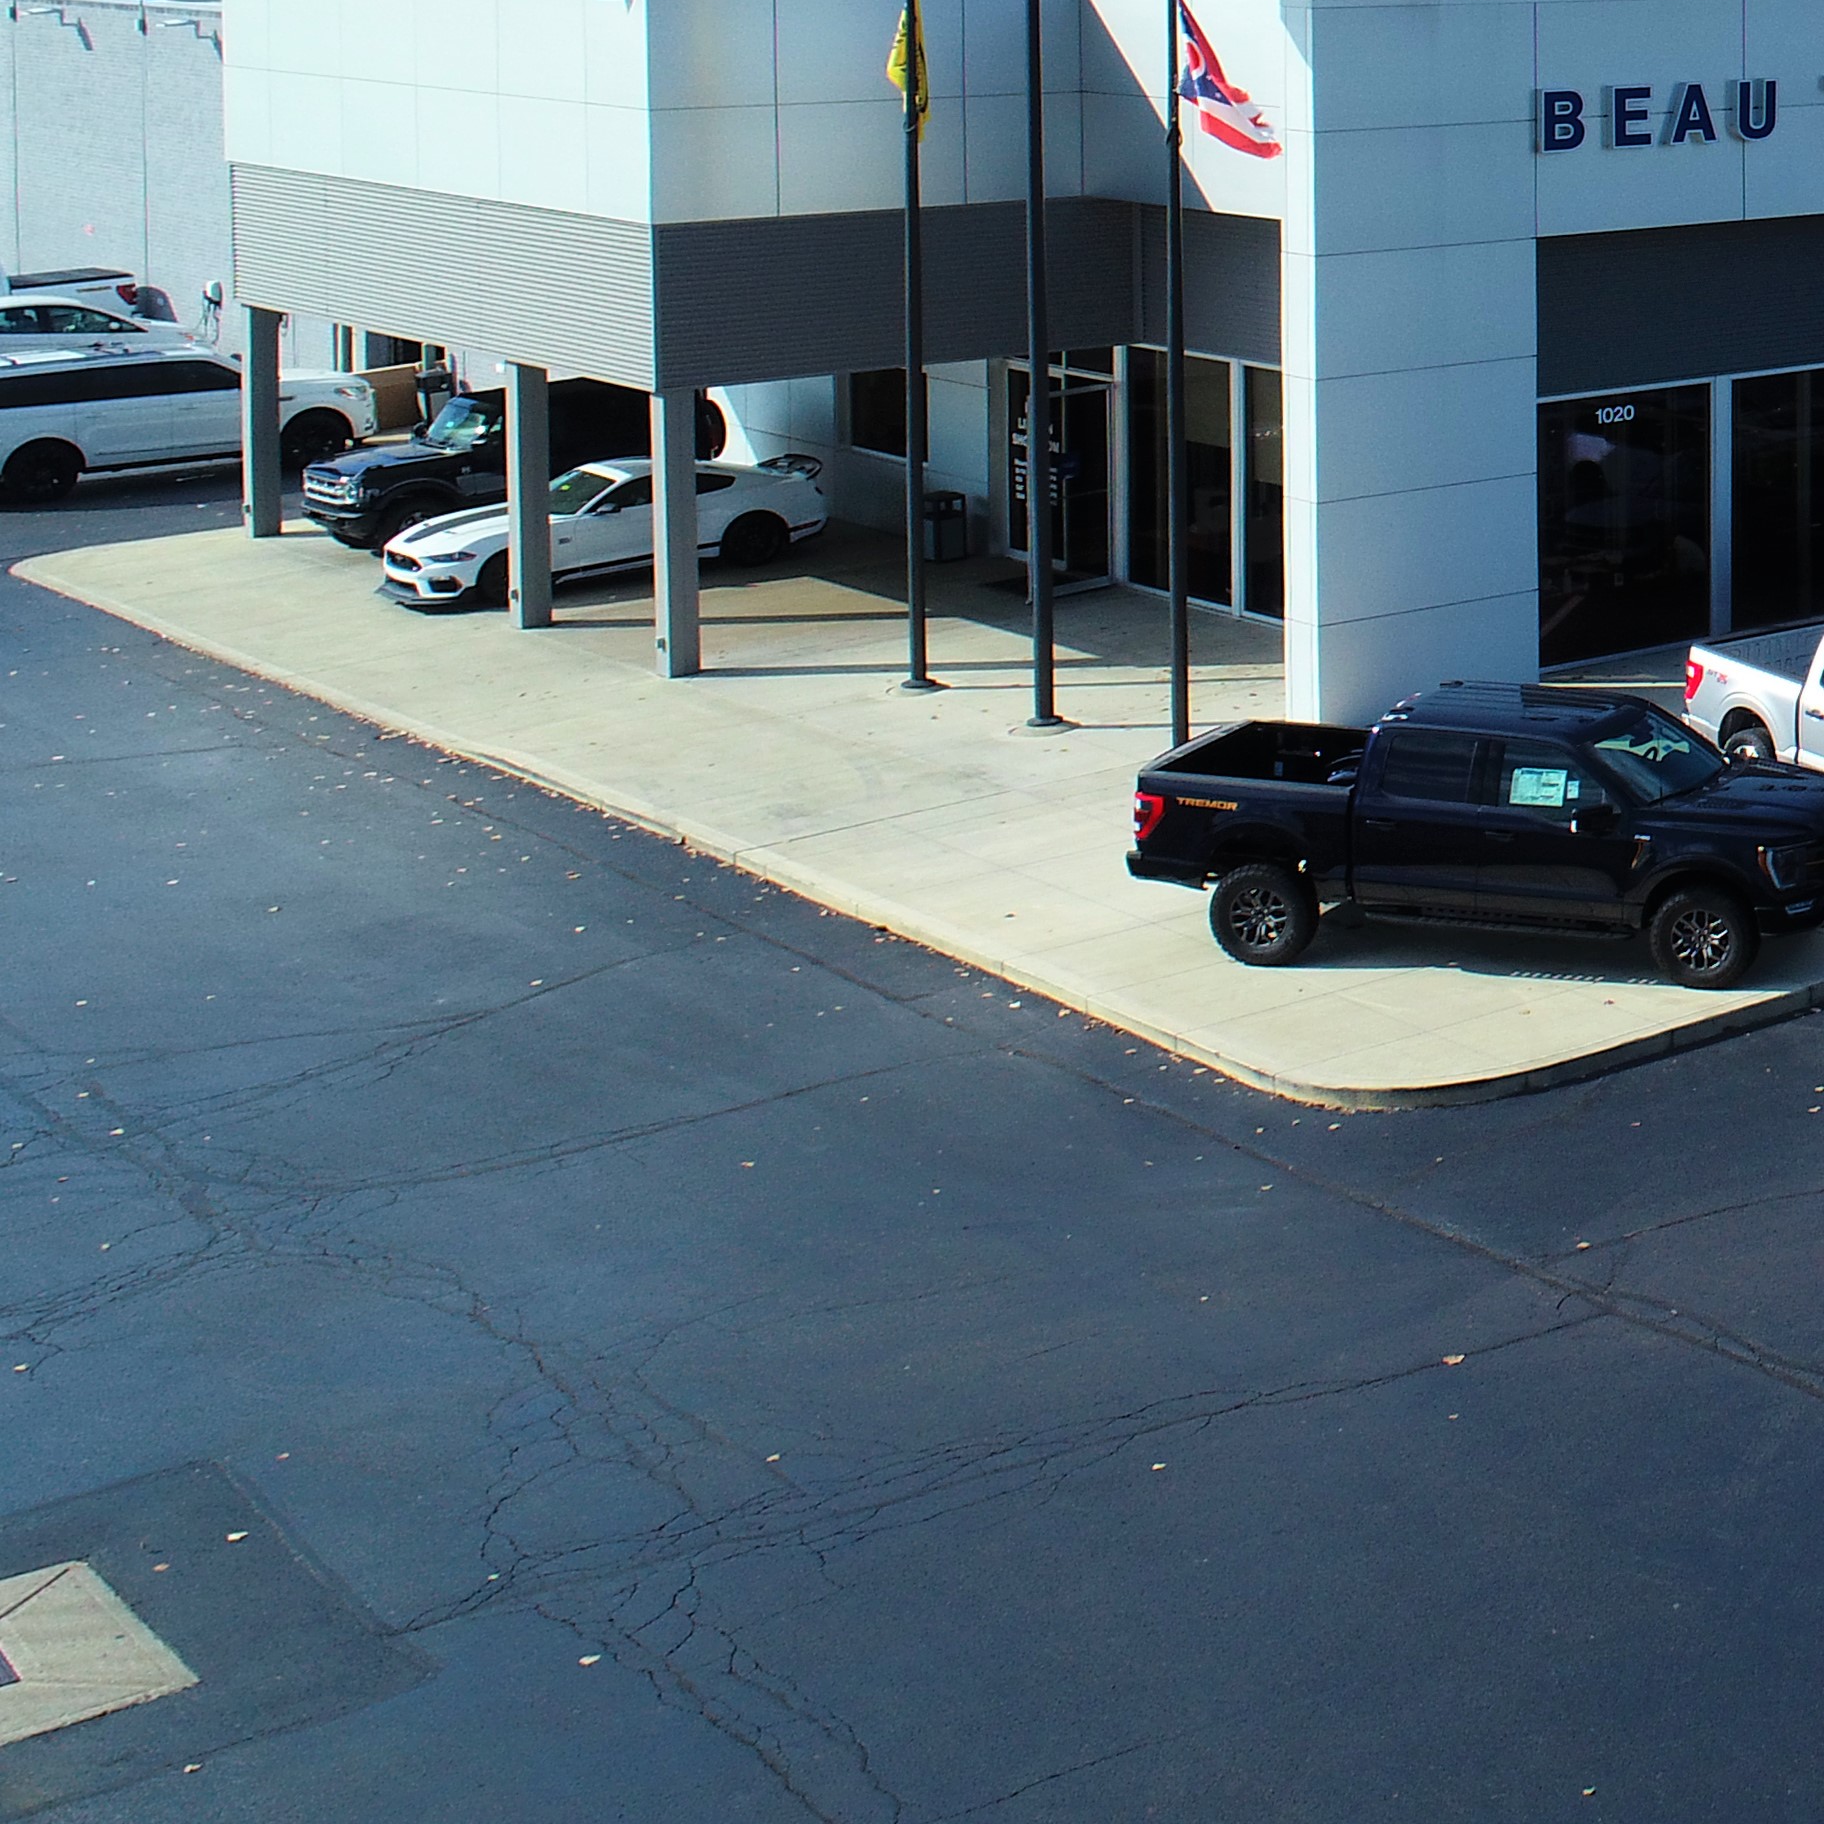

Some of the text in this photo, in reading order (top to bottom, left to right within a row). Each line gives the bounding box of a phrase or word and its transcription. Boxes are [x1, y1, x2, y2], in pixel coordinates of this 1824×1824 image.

[1539, 78, 1779, 153] BEAU
[1595, 405, 1635, 424] 1020
[1175, 796, 1238, 811] TREMOR
